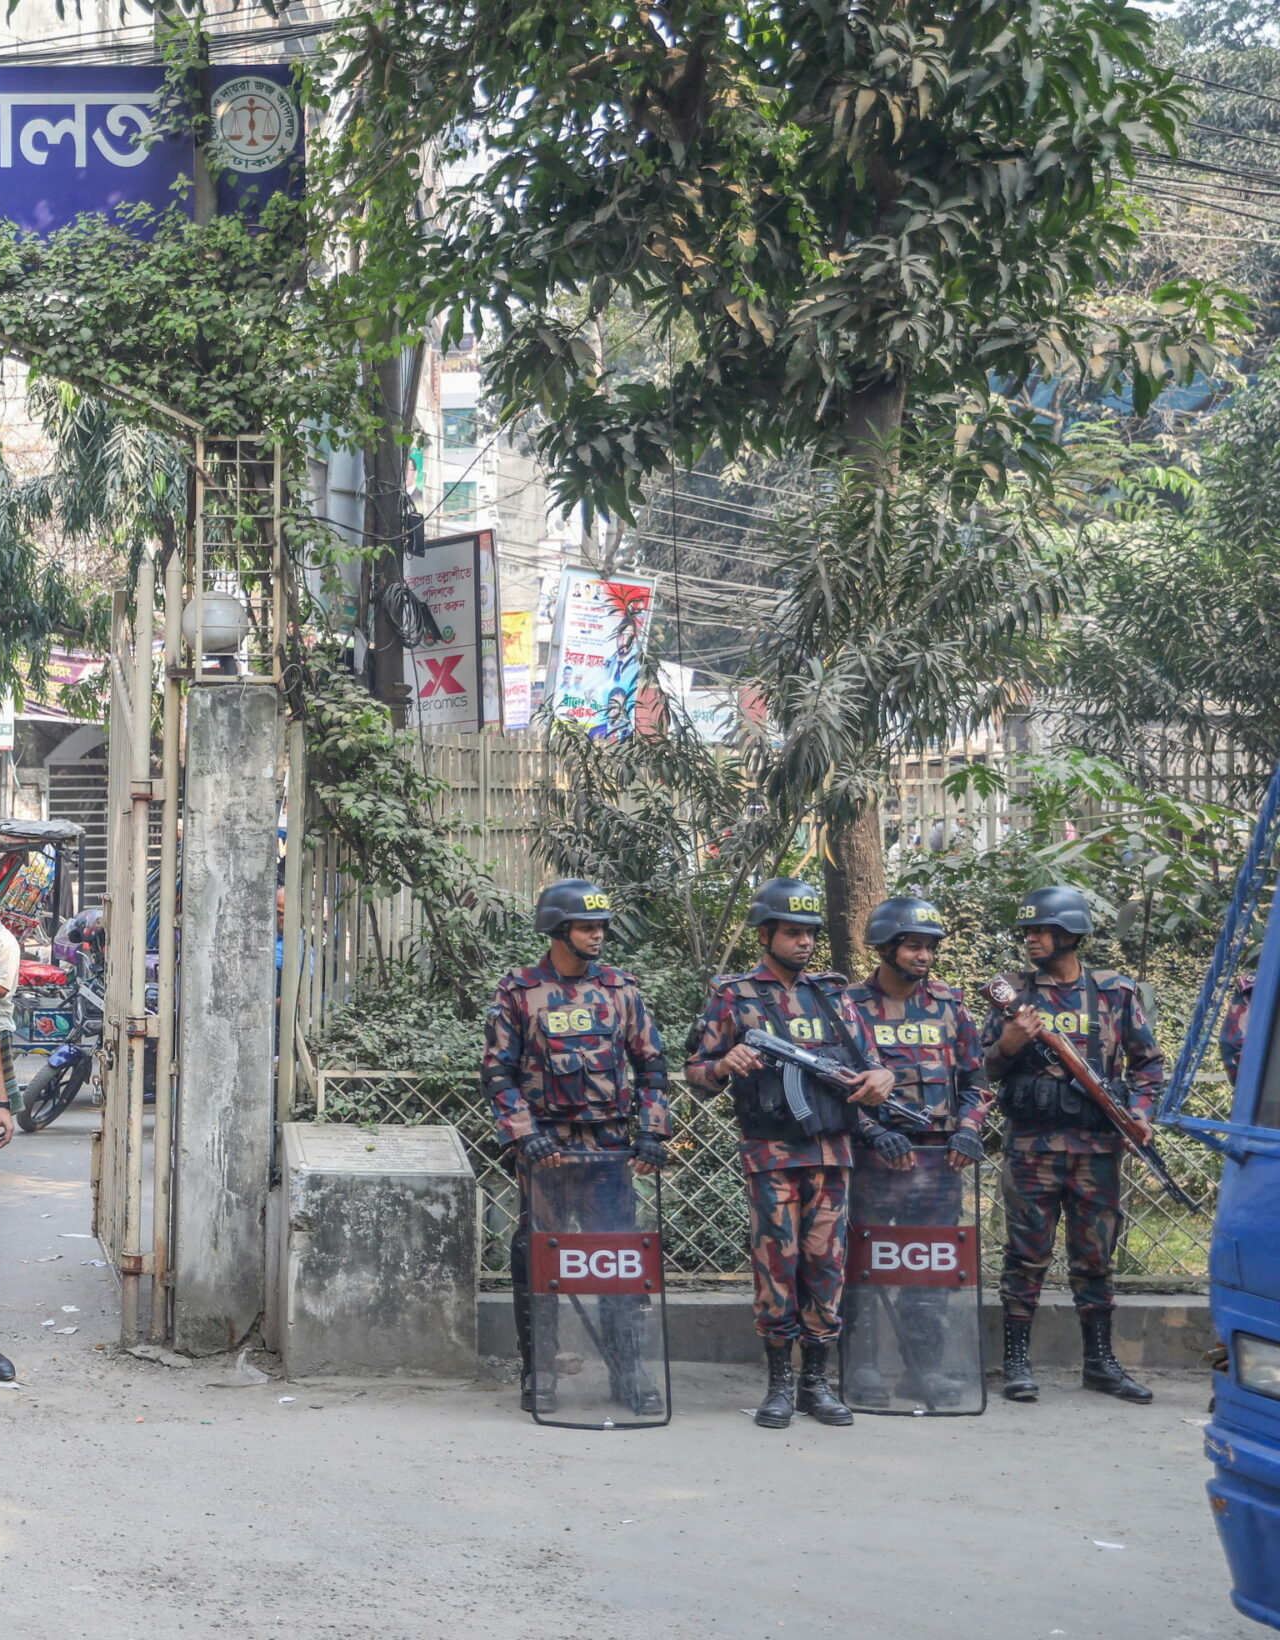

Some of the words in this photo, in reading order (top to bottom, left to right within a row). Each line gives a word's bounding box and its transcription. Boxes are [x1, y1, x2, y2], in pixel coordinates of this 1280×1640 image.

[221, 80, 250, 99] দায়রা
[254, 81, 276, 96] জজ
[277, 92, 294, 139] আদালত
[232, 155, 273, 169] ঢাকা
[789, 896, 820, 912] BGB
[1015, 905, 1036, 919] GB
[915, 908, 943, 924] BG
[874, 1024, 941, 1046] BGB
[559, 1249, 642, 1279] BGB
[871, 1241, 957, 1271] BGB
